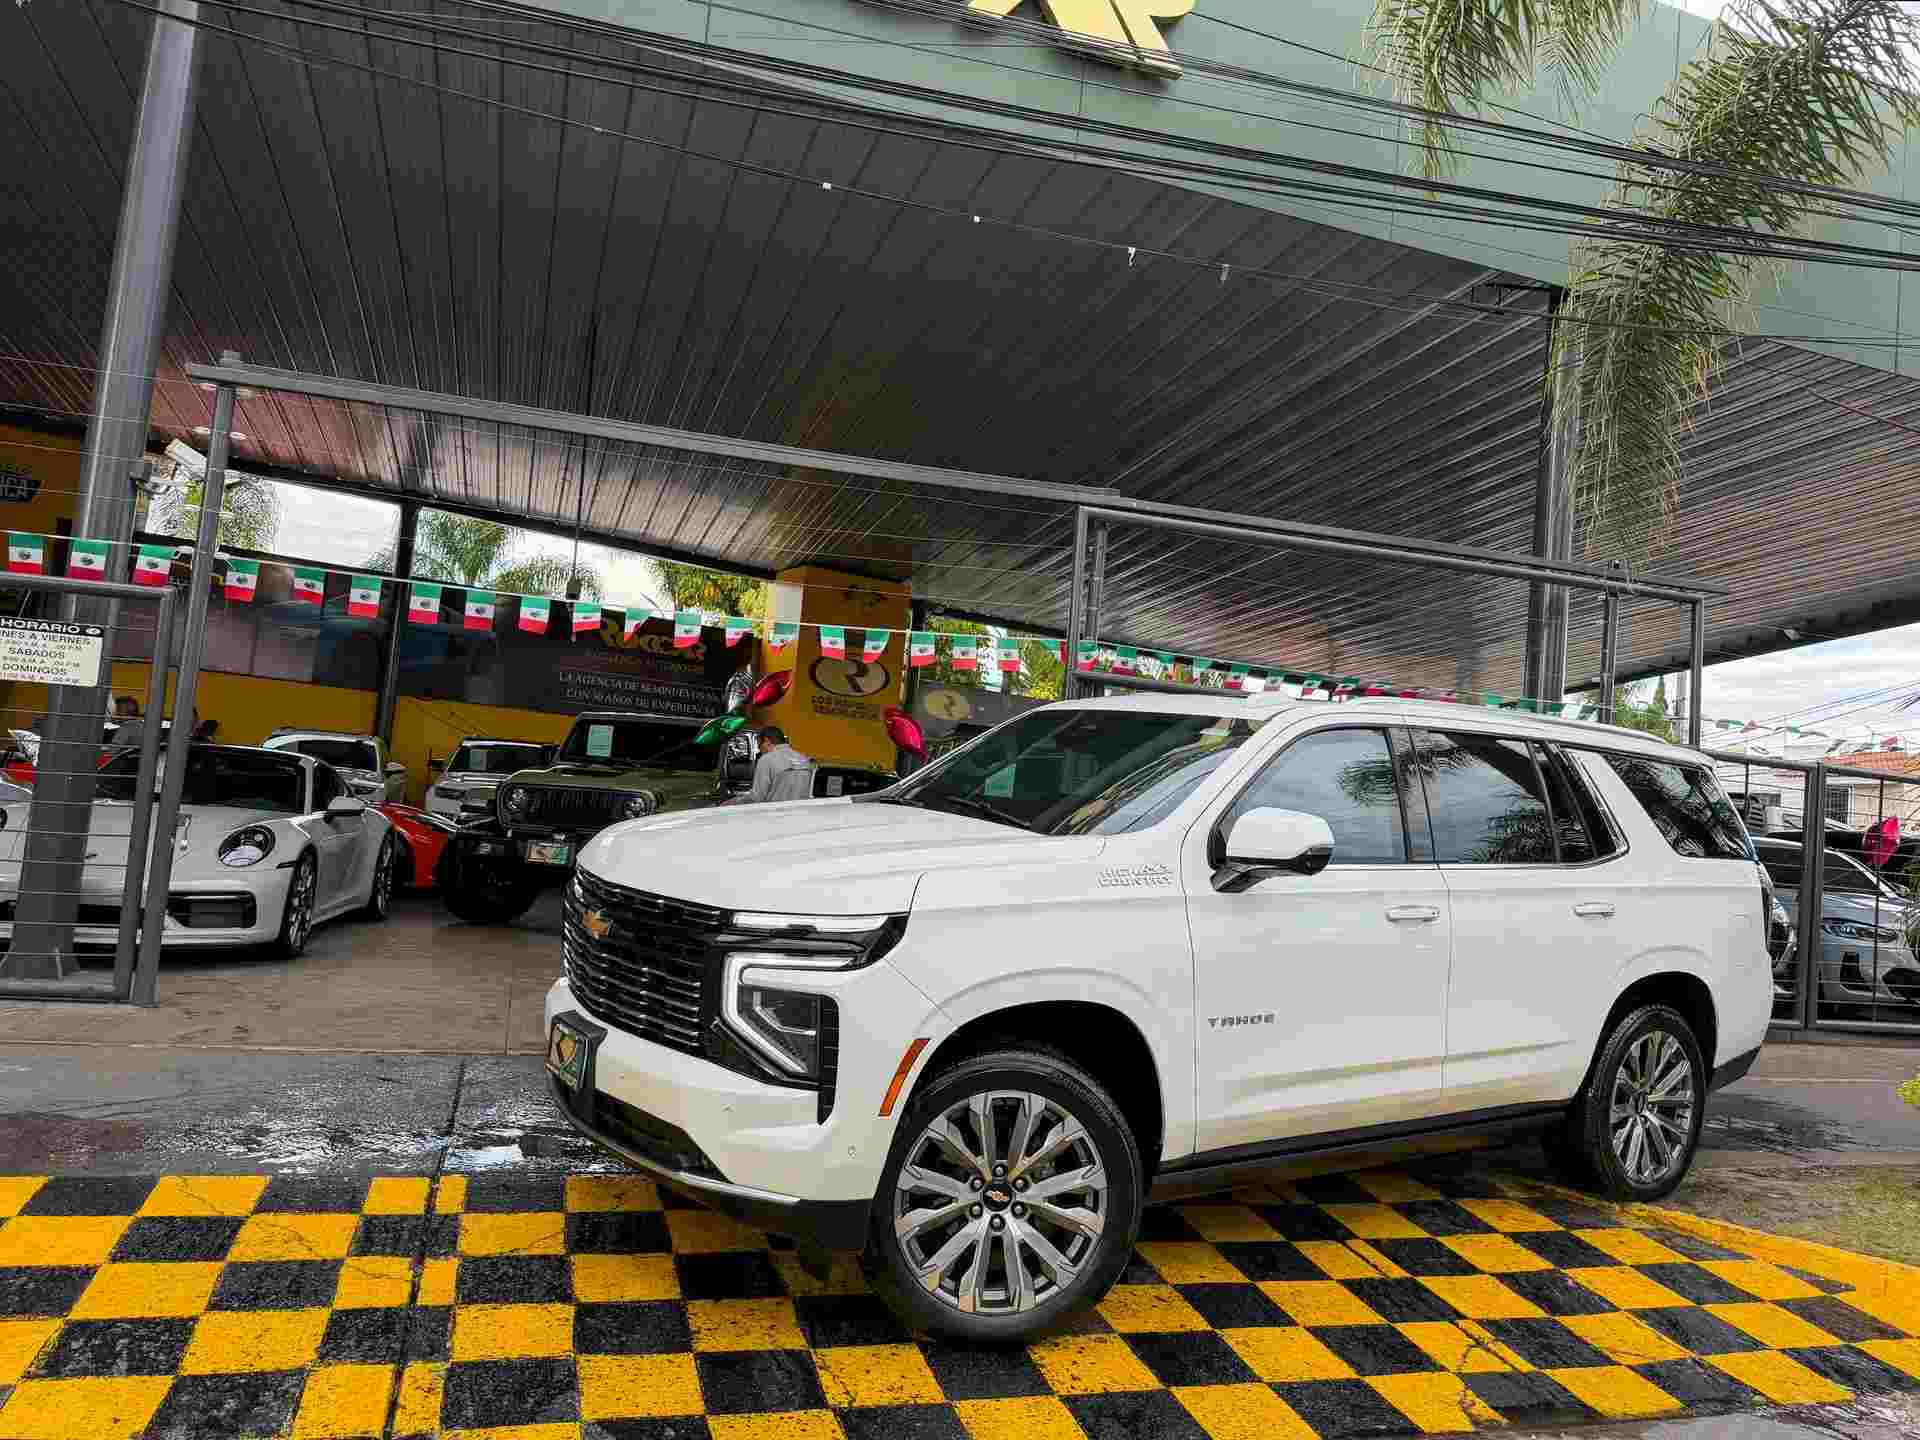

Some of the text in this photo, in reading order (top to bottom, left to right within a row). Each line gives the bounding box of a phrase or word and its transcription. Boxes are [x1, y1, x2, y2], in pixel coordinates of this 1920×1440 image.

[0, 618, 81, 634] HORARIO
[0, 628, 25, 639] NES
[8, 647, 65, 659] SABADOS
[2, 663, 68, 676] DOMINGOS
[575, 673, 622, 689] AGENCIA
[1207, 1013, 1276, 1028] TAHOE
